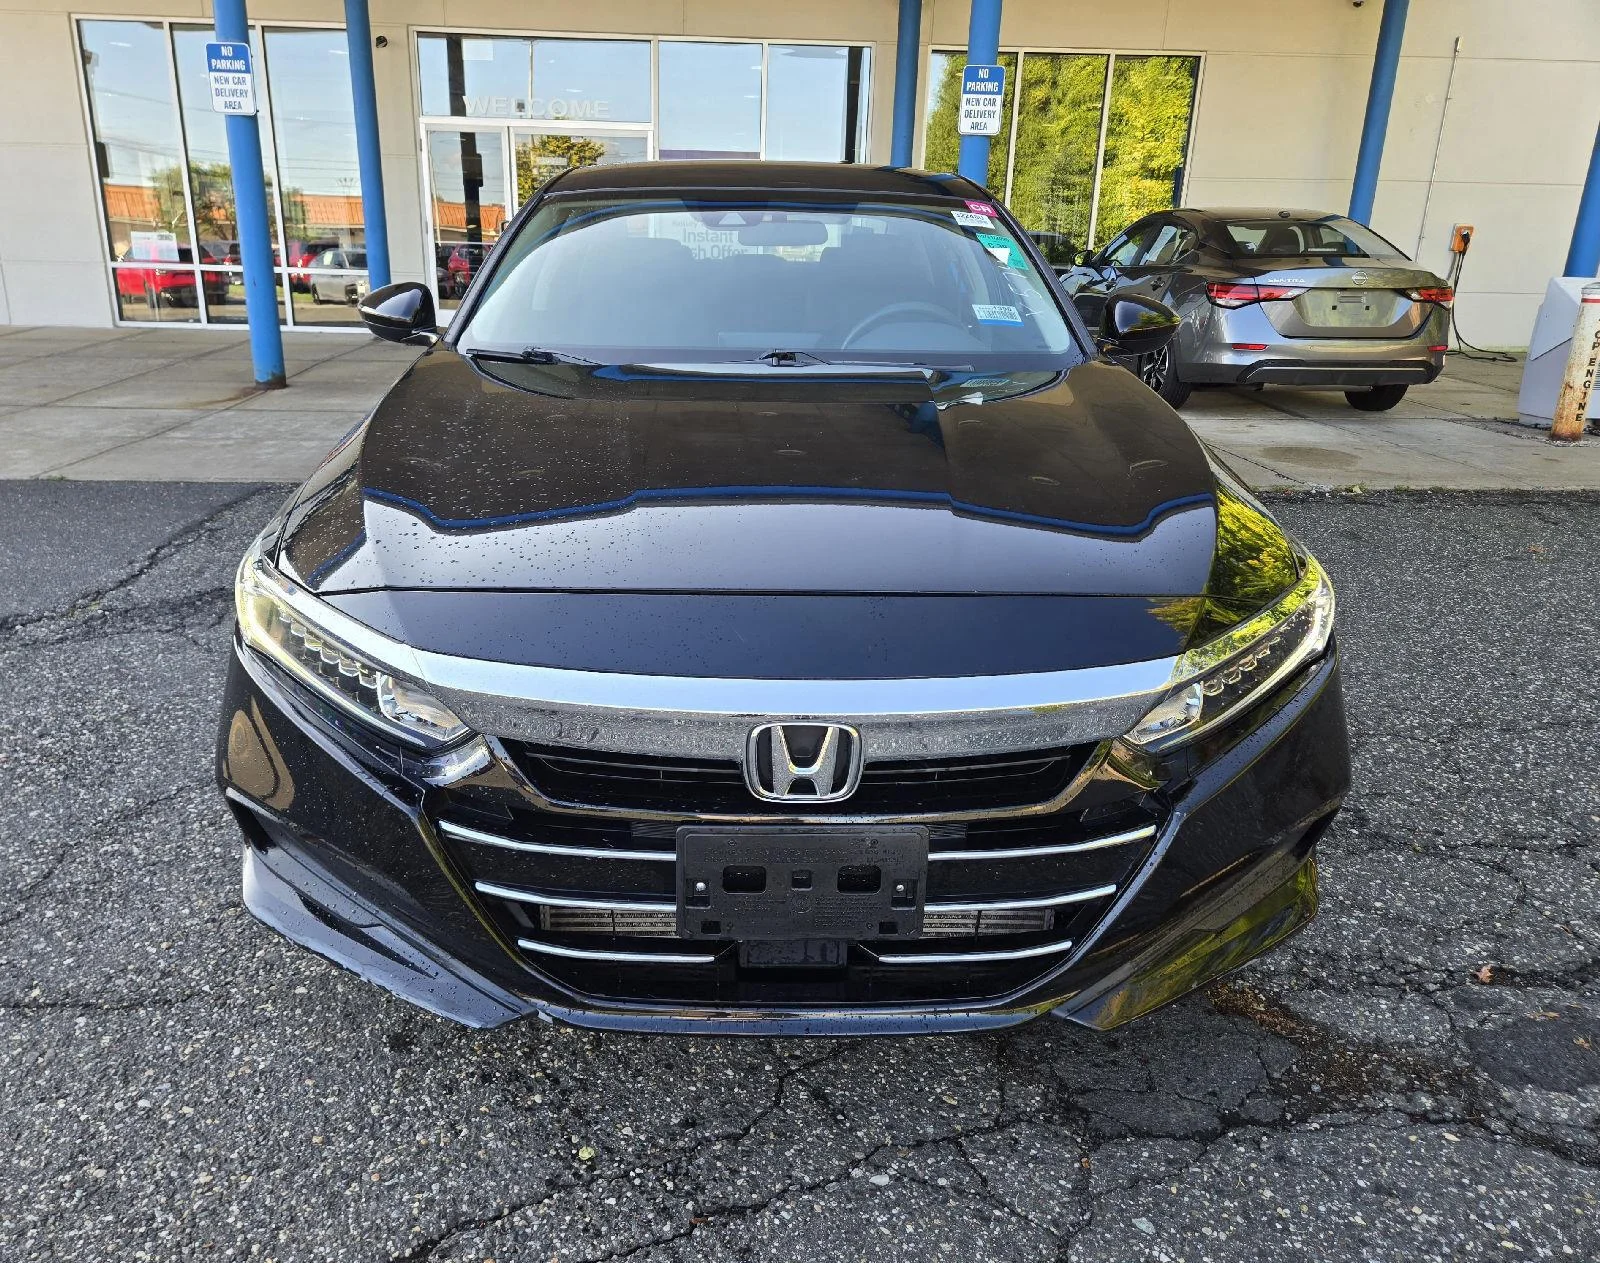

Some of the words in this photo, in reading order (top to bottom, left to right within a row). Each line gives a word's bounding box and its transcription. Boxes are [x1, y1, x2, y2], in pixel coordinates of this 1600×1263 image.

[221, 46, 233, 56] NO
[211, 58, 245, 71] PARKING
[978, 68, 989, 79] NO
[214, 75, 229, 85] NEW
[232, 76, 247, 86] CAR
[966, 81, 999, 92] PARKING
[215, 88, 249, 98] DELIVERY
[224, 101, 242, 110] AREA
[462, 95, 611, 119] WELCOME
[965, 97, 981, 107] NEW
[982, 97, 997, 107] CAR
[964, 109, 997, 119] DELIVERY
[970, 121, 988, 131] AREA
[683, 229, 734, 243] Instant
[1575, 357, 1596, 421] ENGINE
